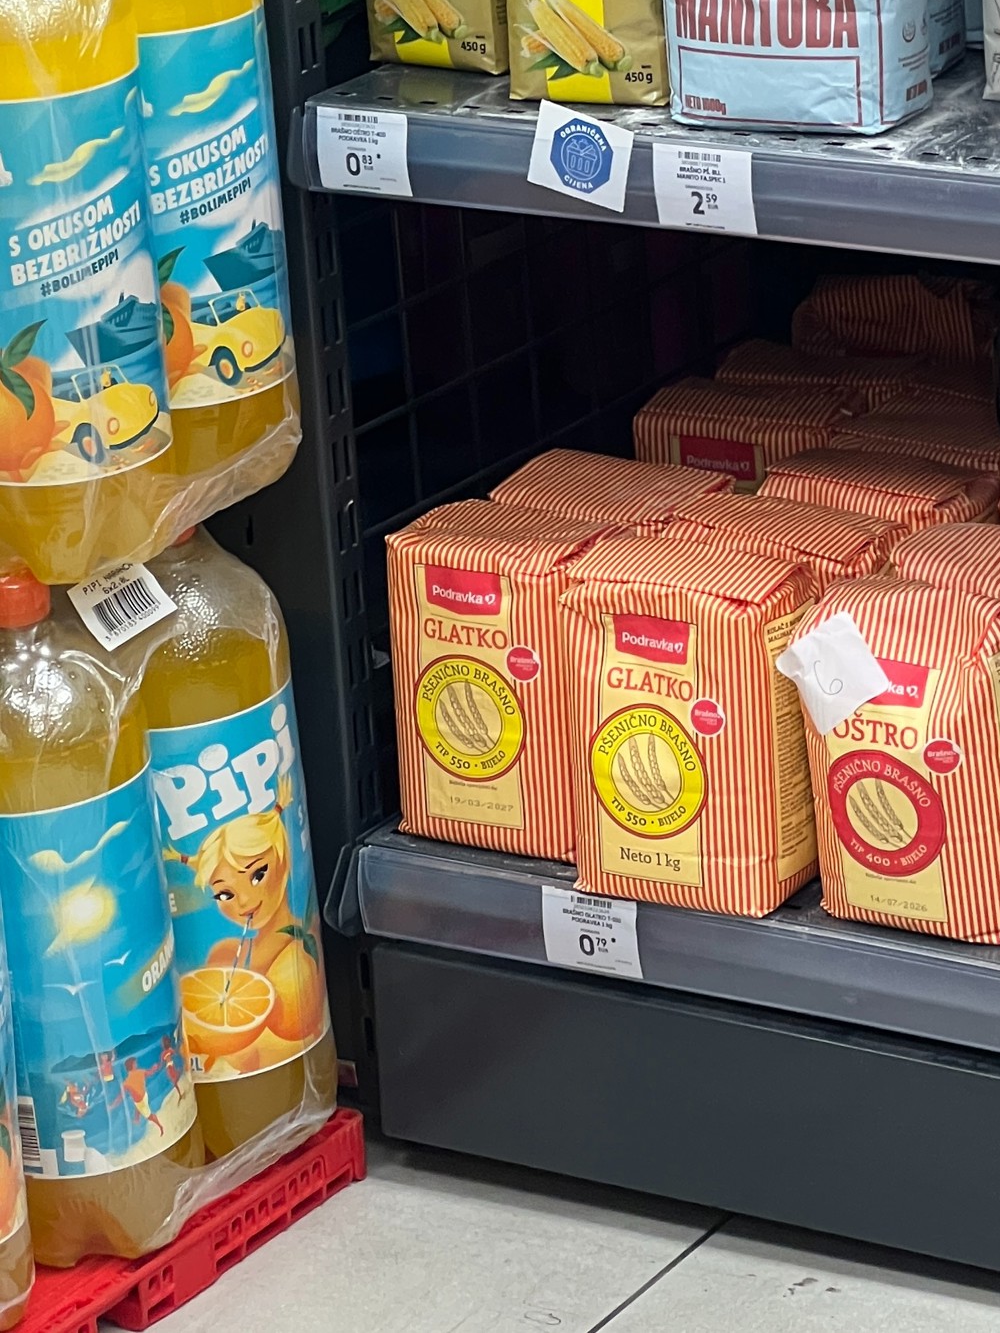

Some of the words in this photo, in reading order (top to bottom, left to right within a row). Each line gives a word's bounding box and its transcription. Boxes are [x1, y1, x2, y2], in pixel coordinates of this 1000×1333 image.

[625, 71, 644, 83] 450
[645, 73, 653, 85] g
[148, 163, 161, 187] S
[168, 124, 247, 180] OKUSOM
[346, 152, 361, 176] 0
[362, 155, 373, 165] 83
[151, 135, 269, 215] BEZBRIŽNOSTI
[563, 174, 593, 190] CIJENA
[179, 177, 252, 224] #BOLIMEPIPI
[691, 191, 706, 215] 2
[707, 193, 718, 203] 59
[8, 234, 21, 258] S
[28, 194, 114, 249] OKUSOM
[11, 200, 141, 287] BEZBRIŽNOSTI
[39, 248, 119, 298] #BOLIMEPIPI
[432, 585, 483, 605] Podravka
[424, 618, 508, 650] GLATKO
[621, 631, 674, 652] Podravka
[421, 664, 470, 703] PŠENIČNO
[474, 667, 516, 717] BRAŠNO
[607, 666, 693, 702] GLATKO
[598, 714, 658, 756] PŠENIČNO
[659, 718, 698, 773] BRAŠNO
[833, 709, 918, 750] OŠTRO
[153, 703, 296, 842] Pipi
[832, 760, 881, 794] PŠENIČNO
[883, 763, 932, 809] BRAŠNO
[449, 796, 514, 813] 19/03/2027
[610, 796, 626, 814] TIP
[625, 811, 647, 826] 550
[658, 805, 687, 828] BIJELO
[619, 847, 652, 865] Neto
[656, 853, 661, 867] 1
[664, 851, 680, 872] kg
[869, 894, 929, 913] 14/07/2026
[579, 933, 594, 956] 0
[595, 937, 607, 947] 79
